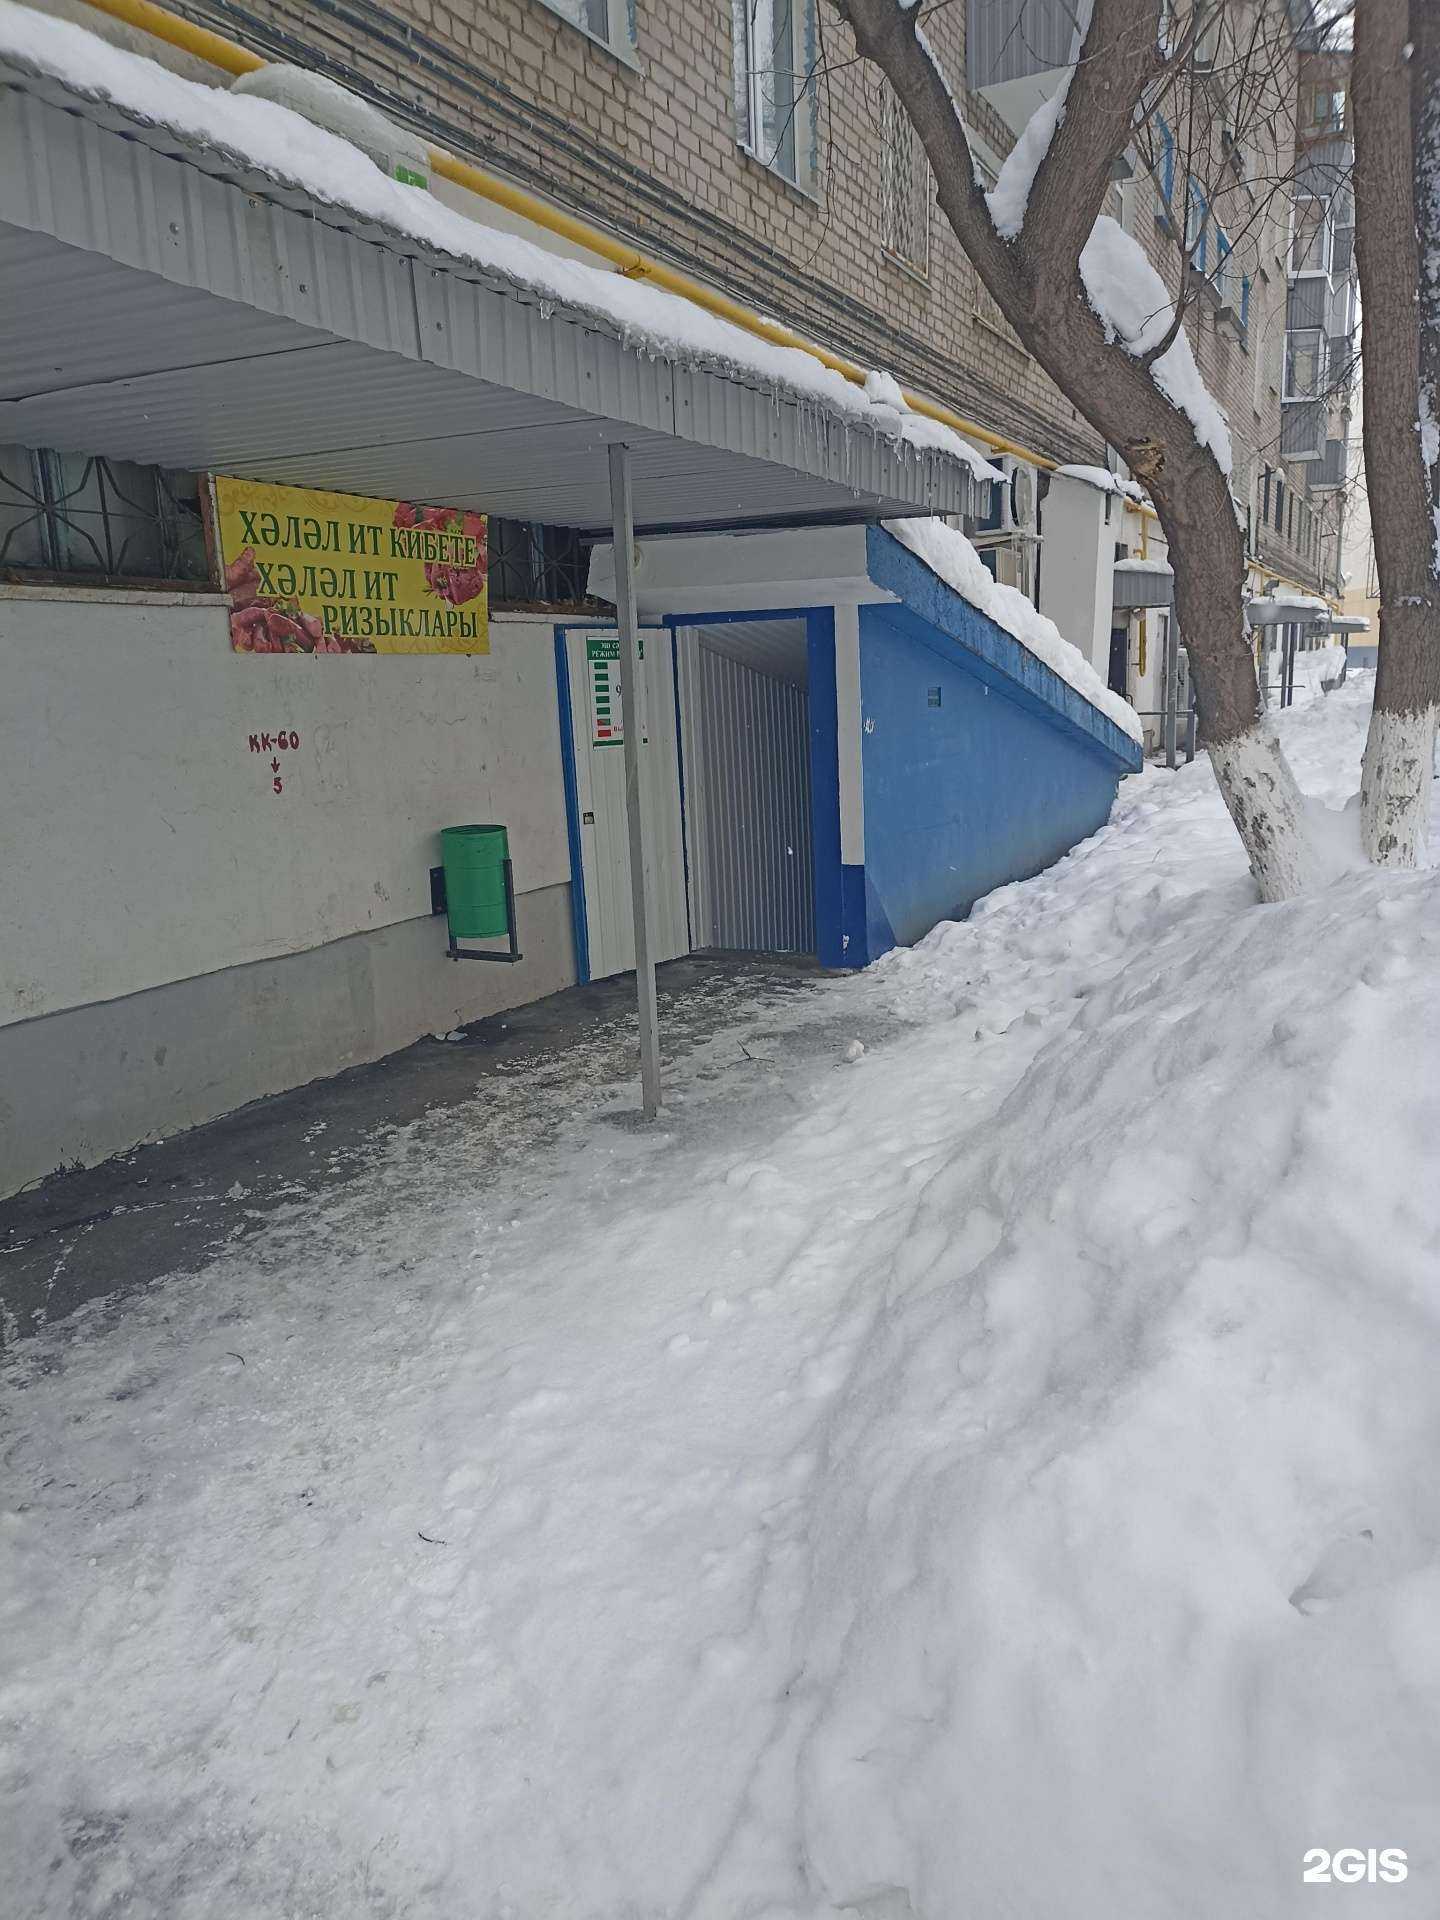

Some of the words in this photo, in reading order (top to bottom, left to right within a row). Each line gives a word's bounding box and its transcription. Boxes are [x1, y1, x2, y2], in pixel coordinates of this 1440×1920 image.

[238, 510, 340, 552] ХӘЛӘЛ
[348, 522, 383, 556] ИТ
[389, 527, 478, 566] КИБЕТЕ
[256, 561, 356, 599] ХӘЛӘЛ
[364, 570, 399, 601] ИТ
[322, 604, 479, 639] РИЗЫКЛАРЫ
[273, 776, 283, 795] 5
